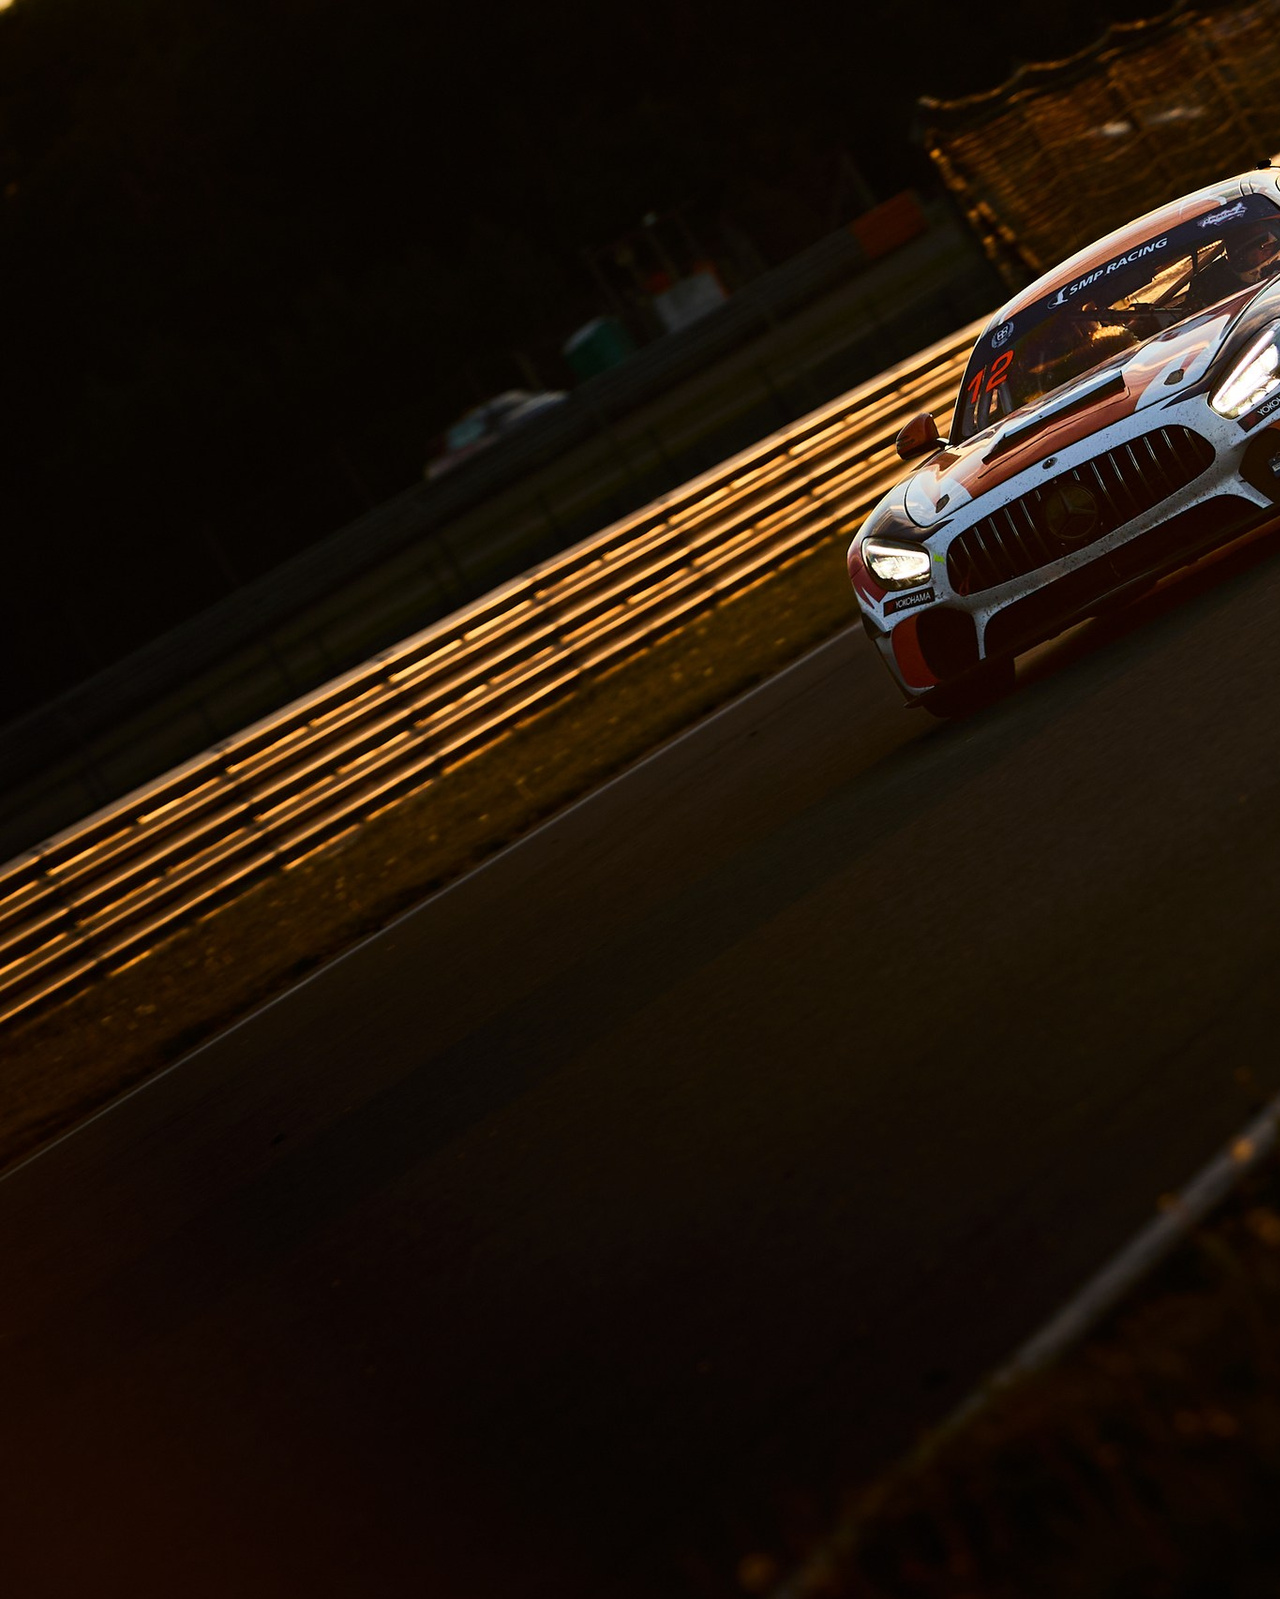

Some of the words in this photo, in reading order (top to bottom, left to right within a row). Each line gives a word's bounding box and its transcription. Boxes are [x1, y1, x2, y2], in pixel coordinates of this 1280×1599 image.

[1069, 269, 1104, 296] SMP
[1106, 238, 1168, 275] RACING
[967, 350, 1015, 404] 12
